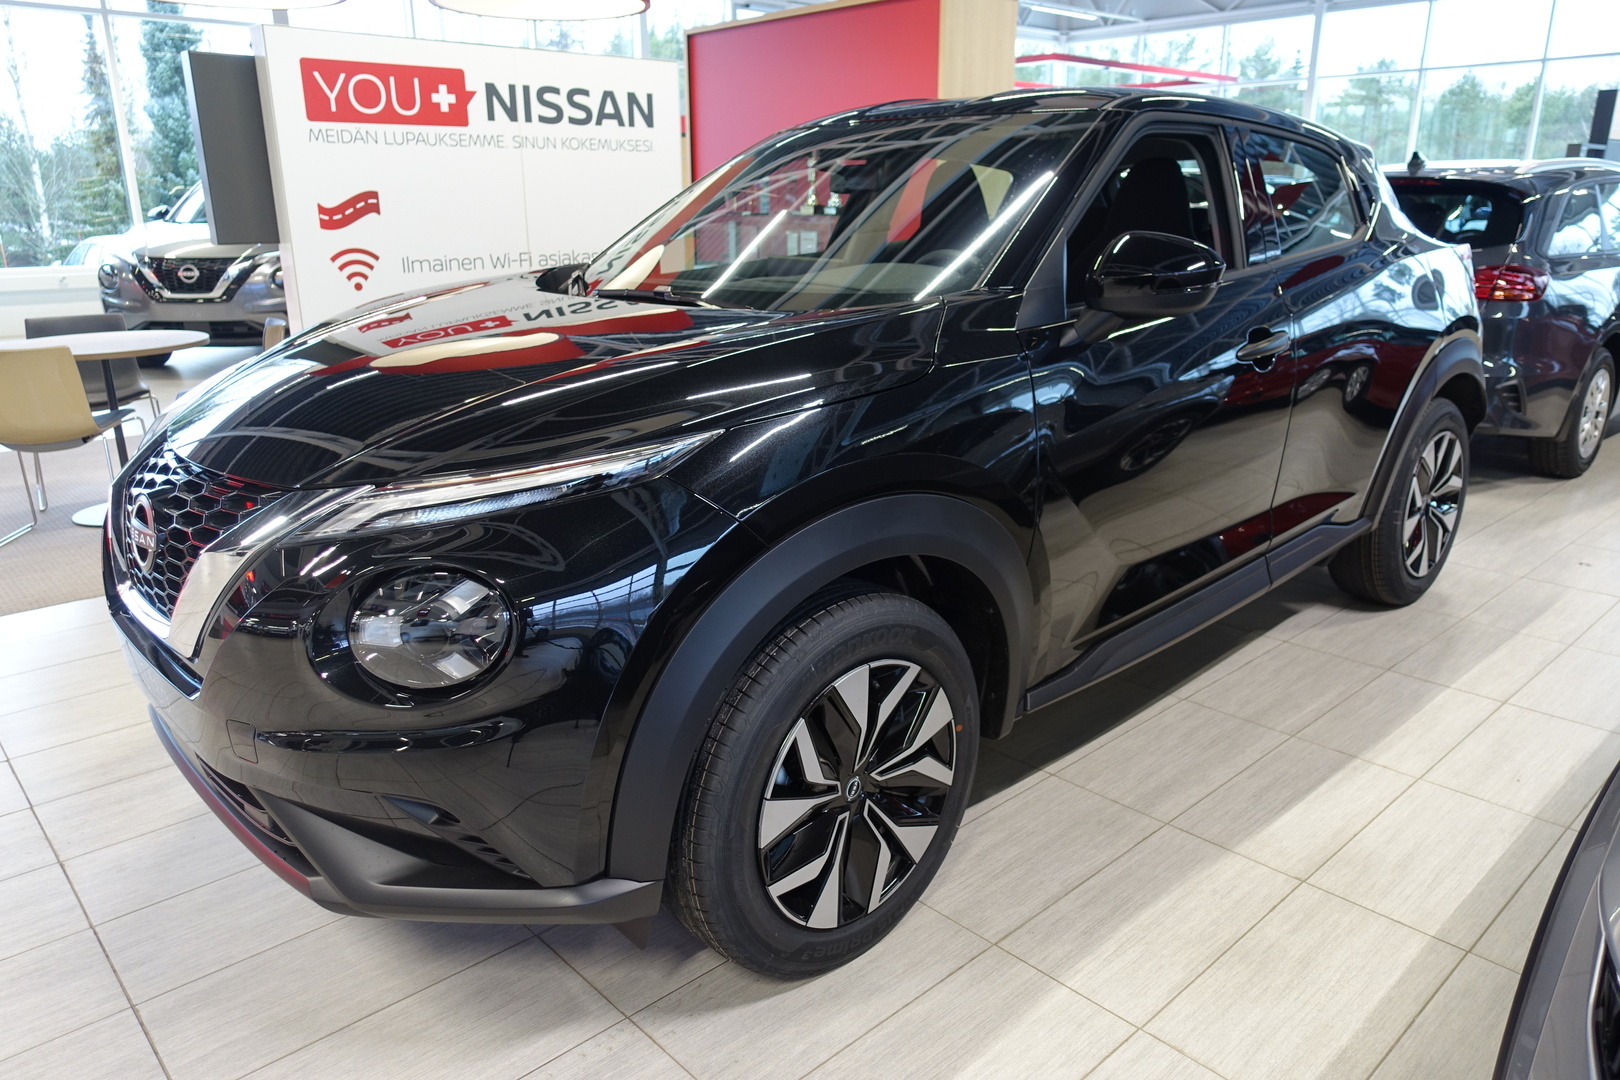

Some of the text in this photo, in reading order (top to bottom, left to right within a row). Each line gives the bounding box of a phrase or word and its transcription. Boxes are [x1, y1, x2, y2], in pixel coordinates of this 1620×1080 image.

[485, 82, 654, 128] NISSAN
[308, 127, 378, 145] MEIDÄN
[384, 131, 509, 149] LUPAUKSEMME.
[512, 135, 557, 150] SINUN
[401, 255, 485, 274] Ilmainen
[490, 252, 533, 268] Wi-Fi
